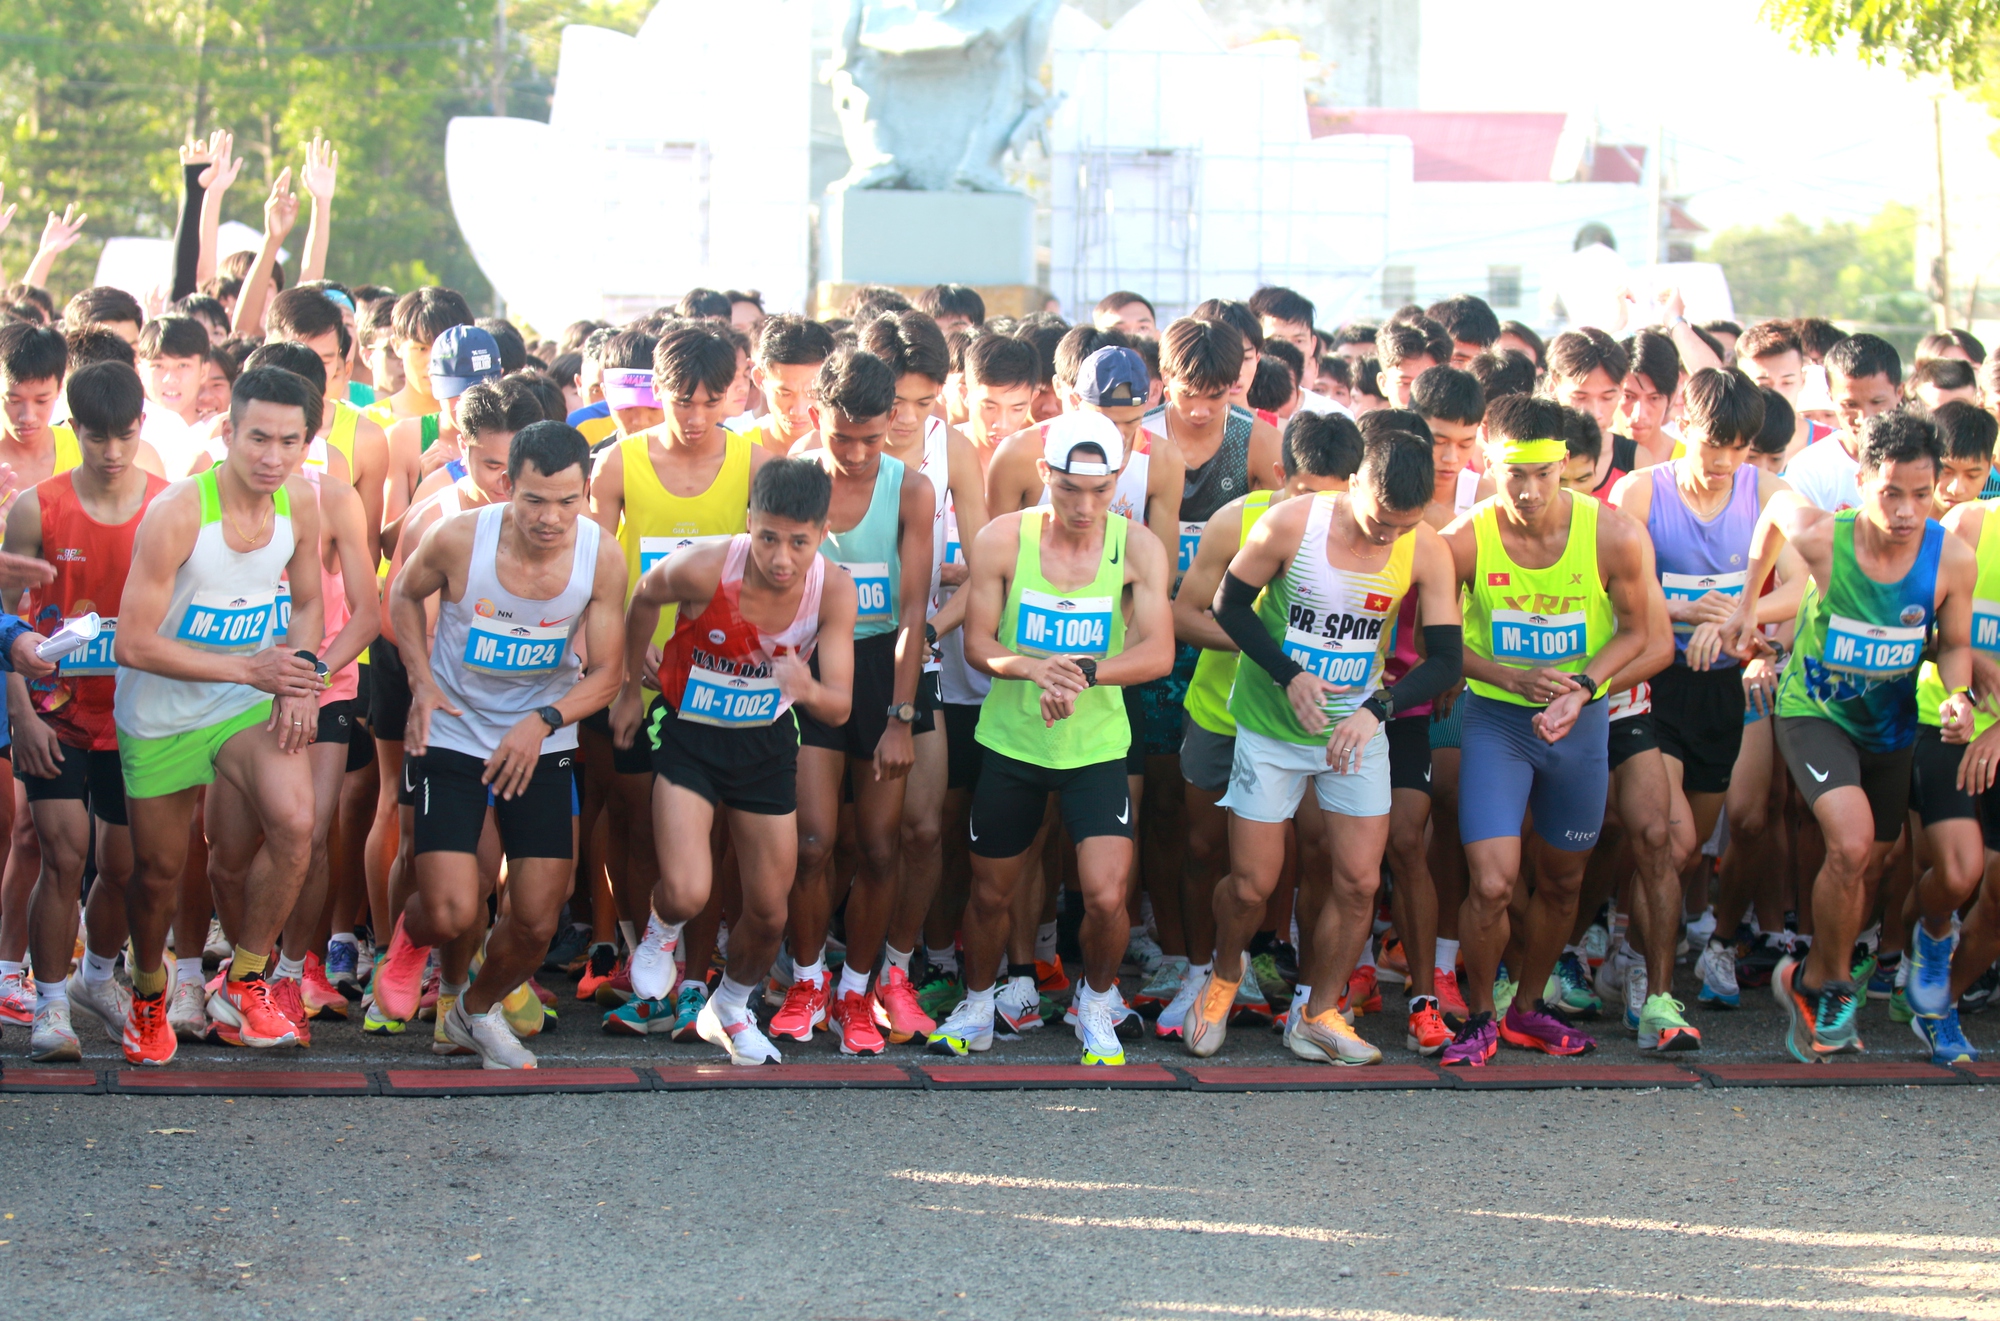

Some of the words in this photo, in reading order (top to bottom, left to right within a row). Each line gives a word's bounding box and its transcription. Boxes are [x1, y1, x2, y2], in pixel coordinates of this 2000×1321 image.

[188, 610, 266, 640] M-1012
[498, 610, 512, 618] NN
[1026, 612, 1104, 646] M-1004
[1290, 604, 1316, 634] PR
[1322, 614, 1386, 640] SPOR
[474, 636, 556, 666] M-1024
[1502, 626, 1578, 655] M-1001
[1833, 636, 1916, 666] M-1026
[1290, 648, 1367, 682] M-1000
[691, 685, 774, 718] M-1002
[1565, 830, 1596, 842] Elite
